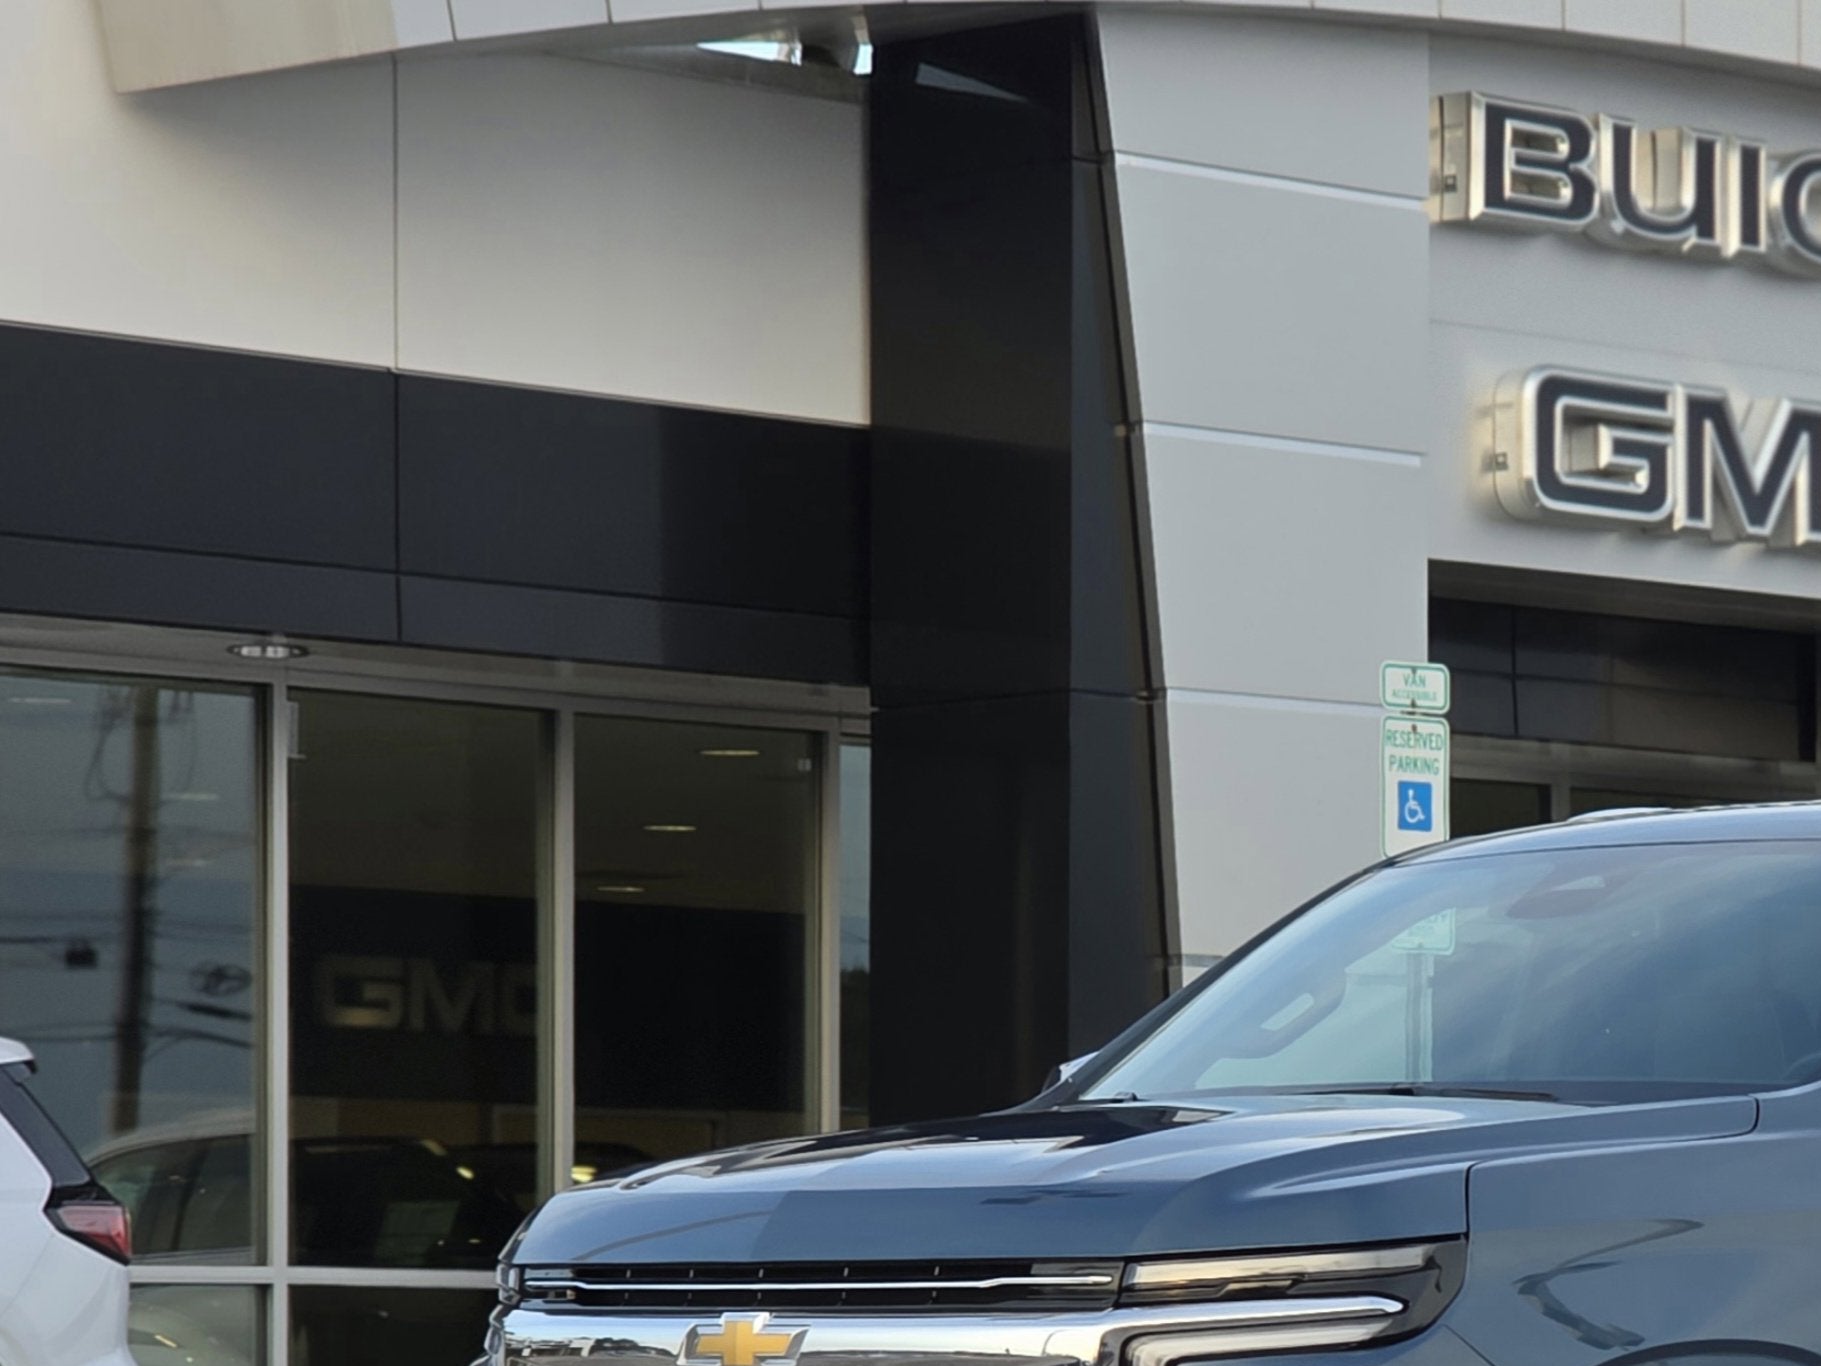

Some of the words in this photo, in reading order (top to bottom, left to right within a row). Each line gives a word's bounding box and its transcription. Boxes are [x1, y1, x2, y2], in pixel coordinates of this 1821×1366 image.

[1403, 674, 1426, 687] VAN
[1391, 689, 1437, 701] ACCESSIBLE
[1385, 729, 1443, 751] RESERVED
[1388, 754, 1440, 775] PARKING
